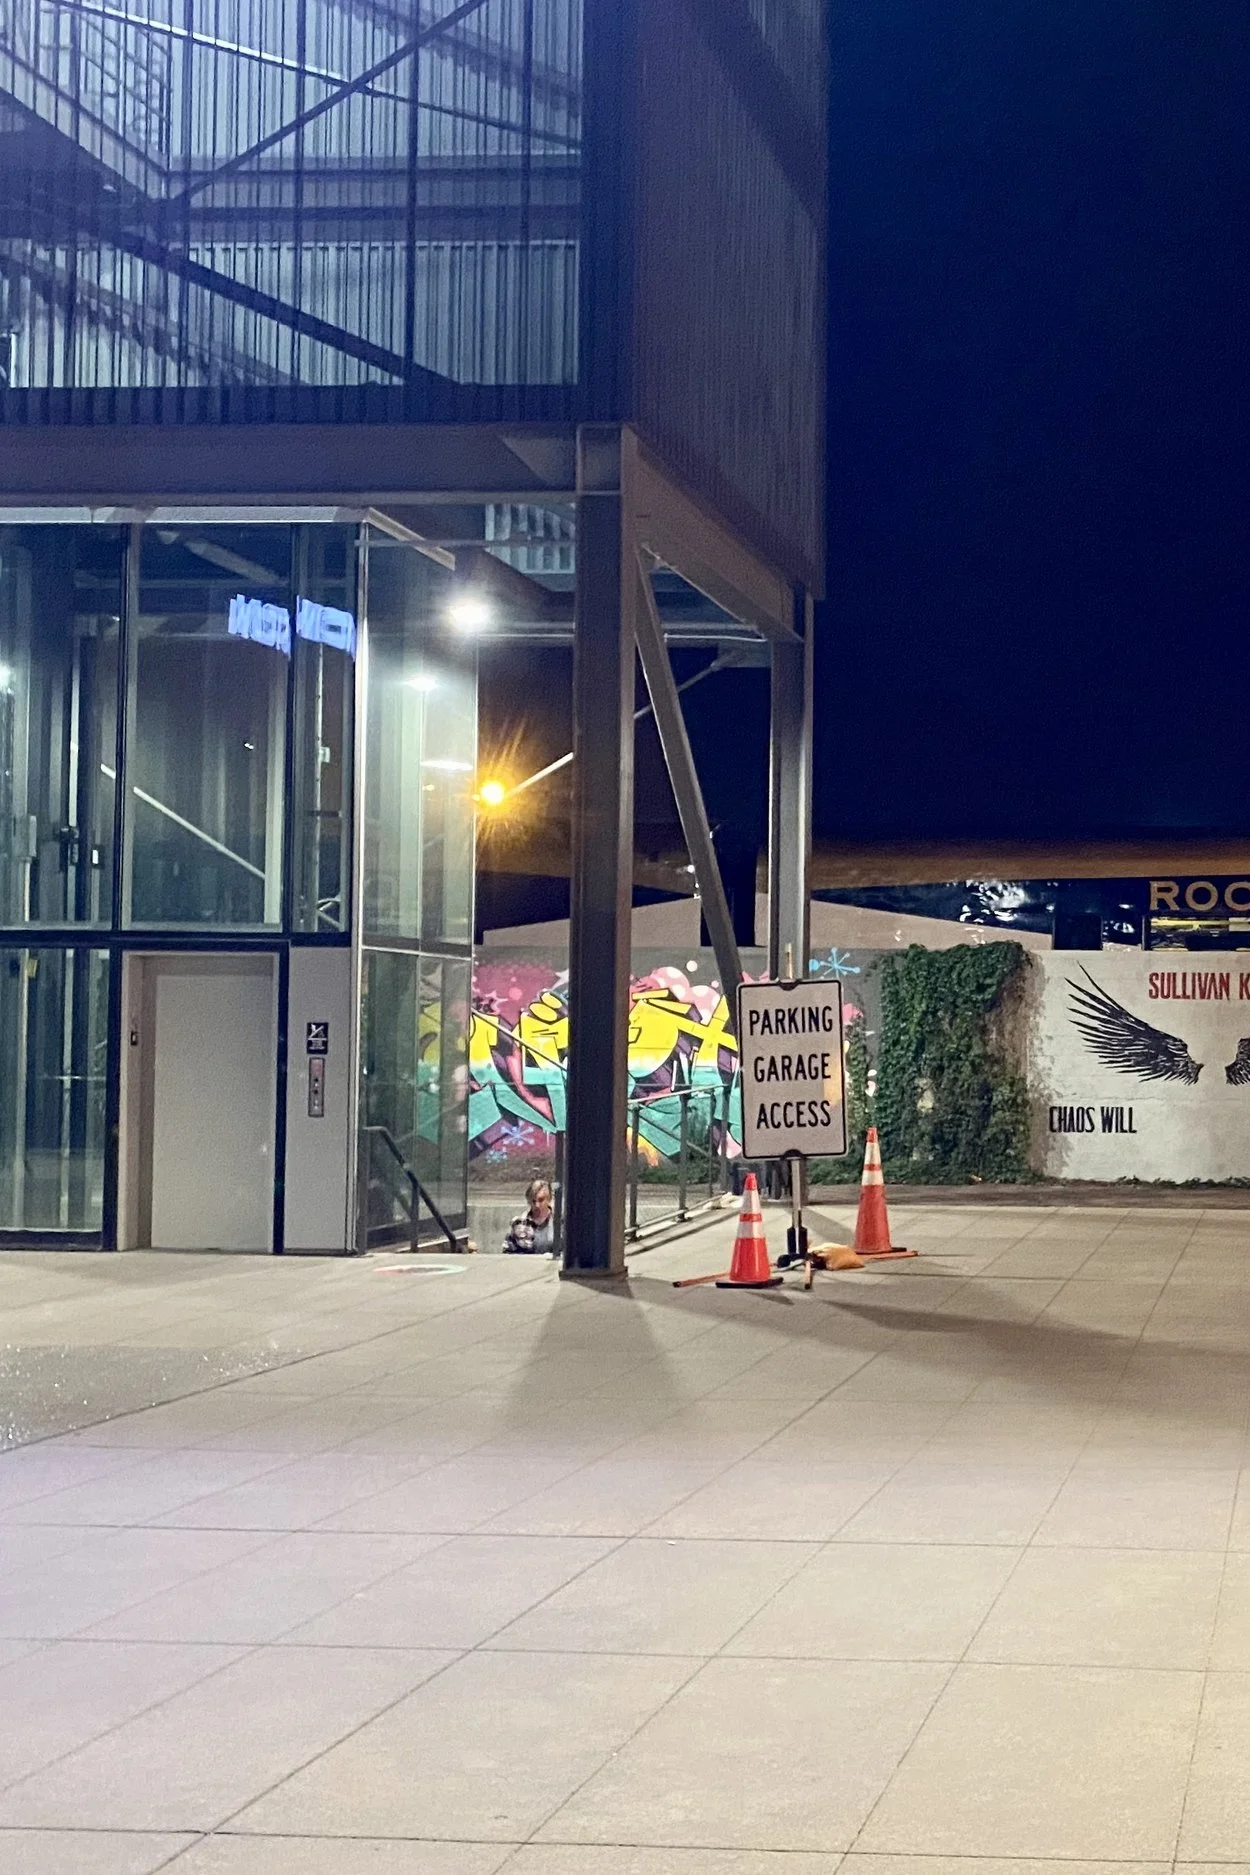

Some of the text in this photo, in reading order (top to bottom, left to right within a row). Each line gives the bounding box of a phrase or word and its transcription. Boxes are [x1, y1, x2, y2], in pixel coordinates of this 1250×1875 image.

[1148, 972, 1231, 1000] SULLIVAN
[749, 1006, 833, 1035] PARKING
[754, 1053, 831, 1082] GARAGE
[756, 1100, 831, 1129] ACCESS
[1048, 1106, 1137, 1134] CHAOS WILL
